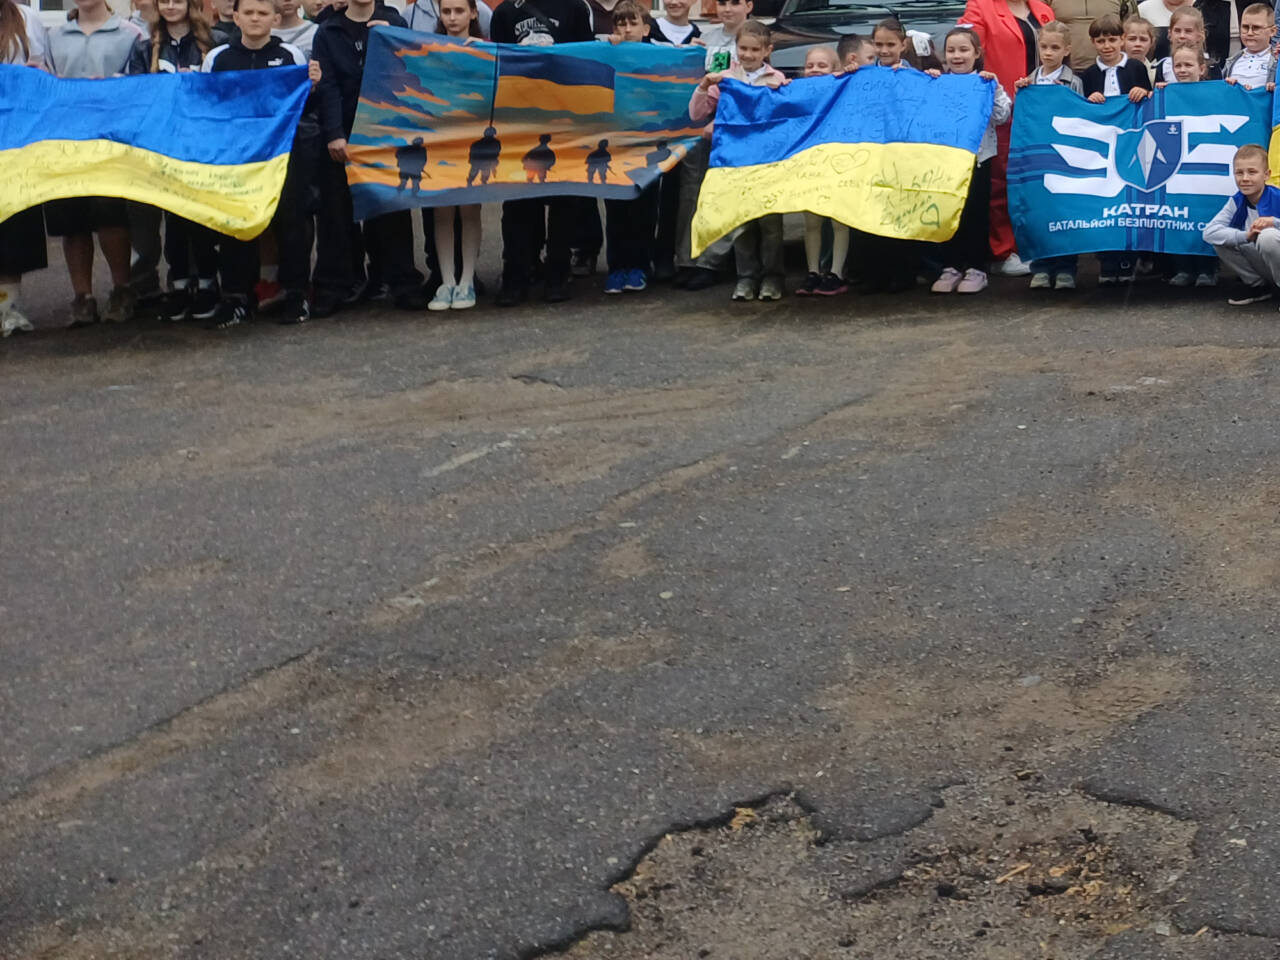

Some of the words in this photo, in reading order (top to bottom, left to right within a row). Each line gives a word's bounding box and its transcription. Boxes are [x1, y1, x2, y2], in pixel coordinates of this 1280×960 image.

[1103, 203, 1189, 219] КАТРАН
[1048, 217, 1114, 232] БАТАЛЬЙОН
[1117, 217, 1195, 232] БЕЗПІЛОТНИХ
